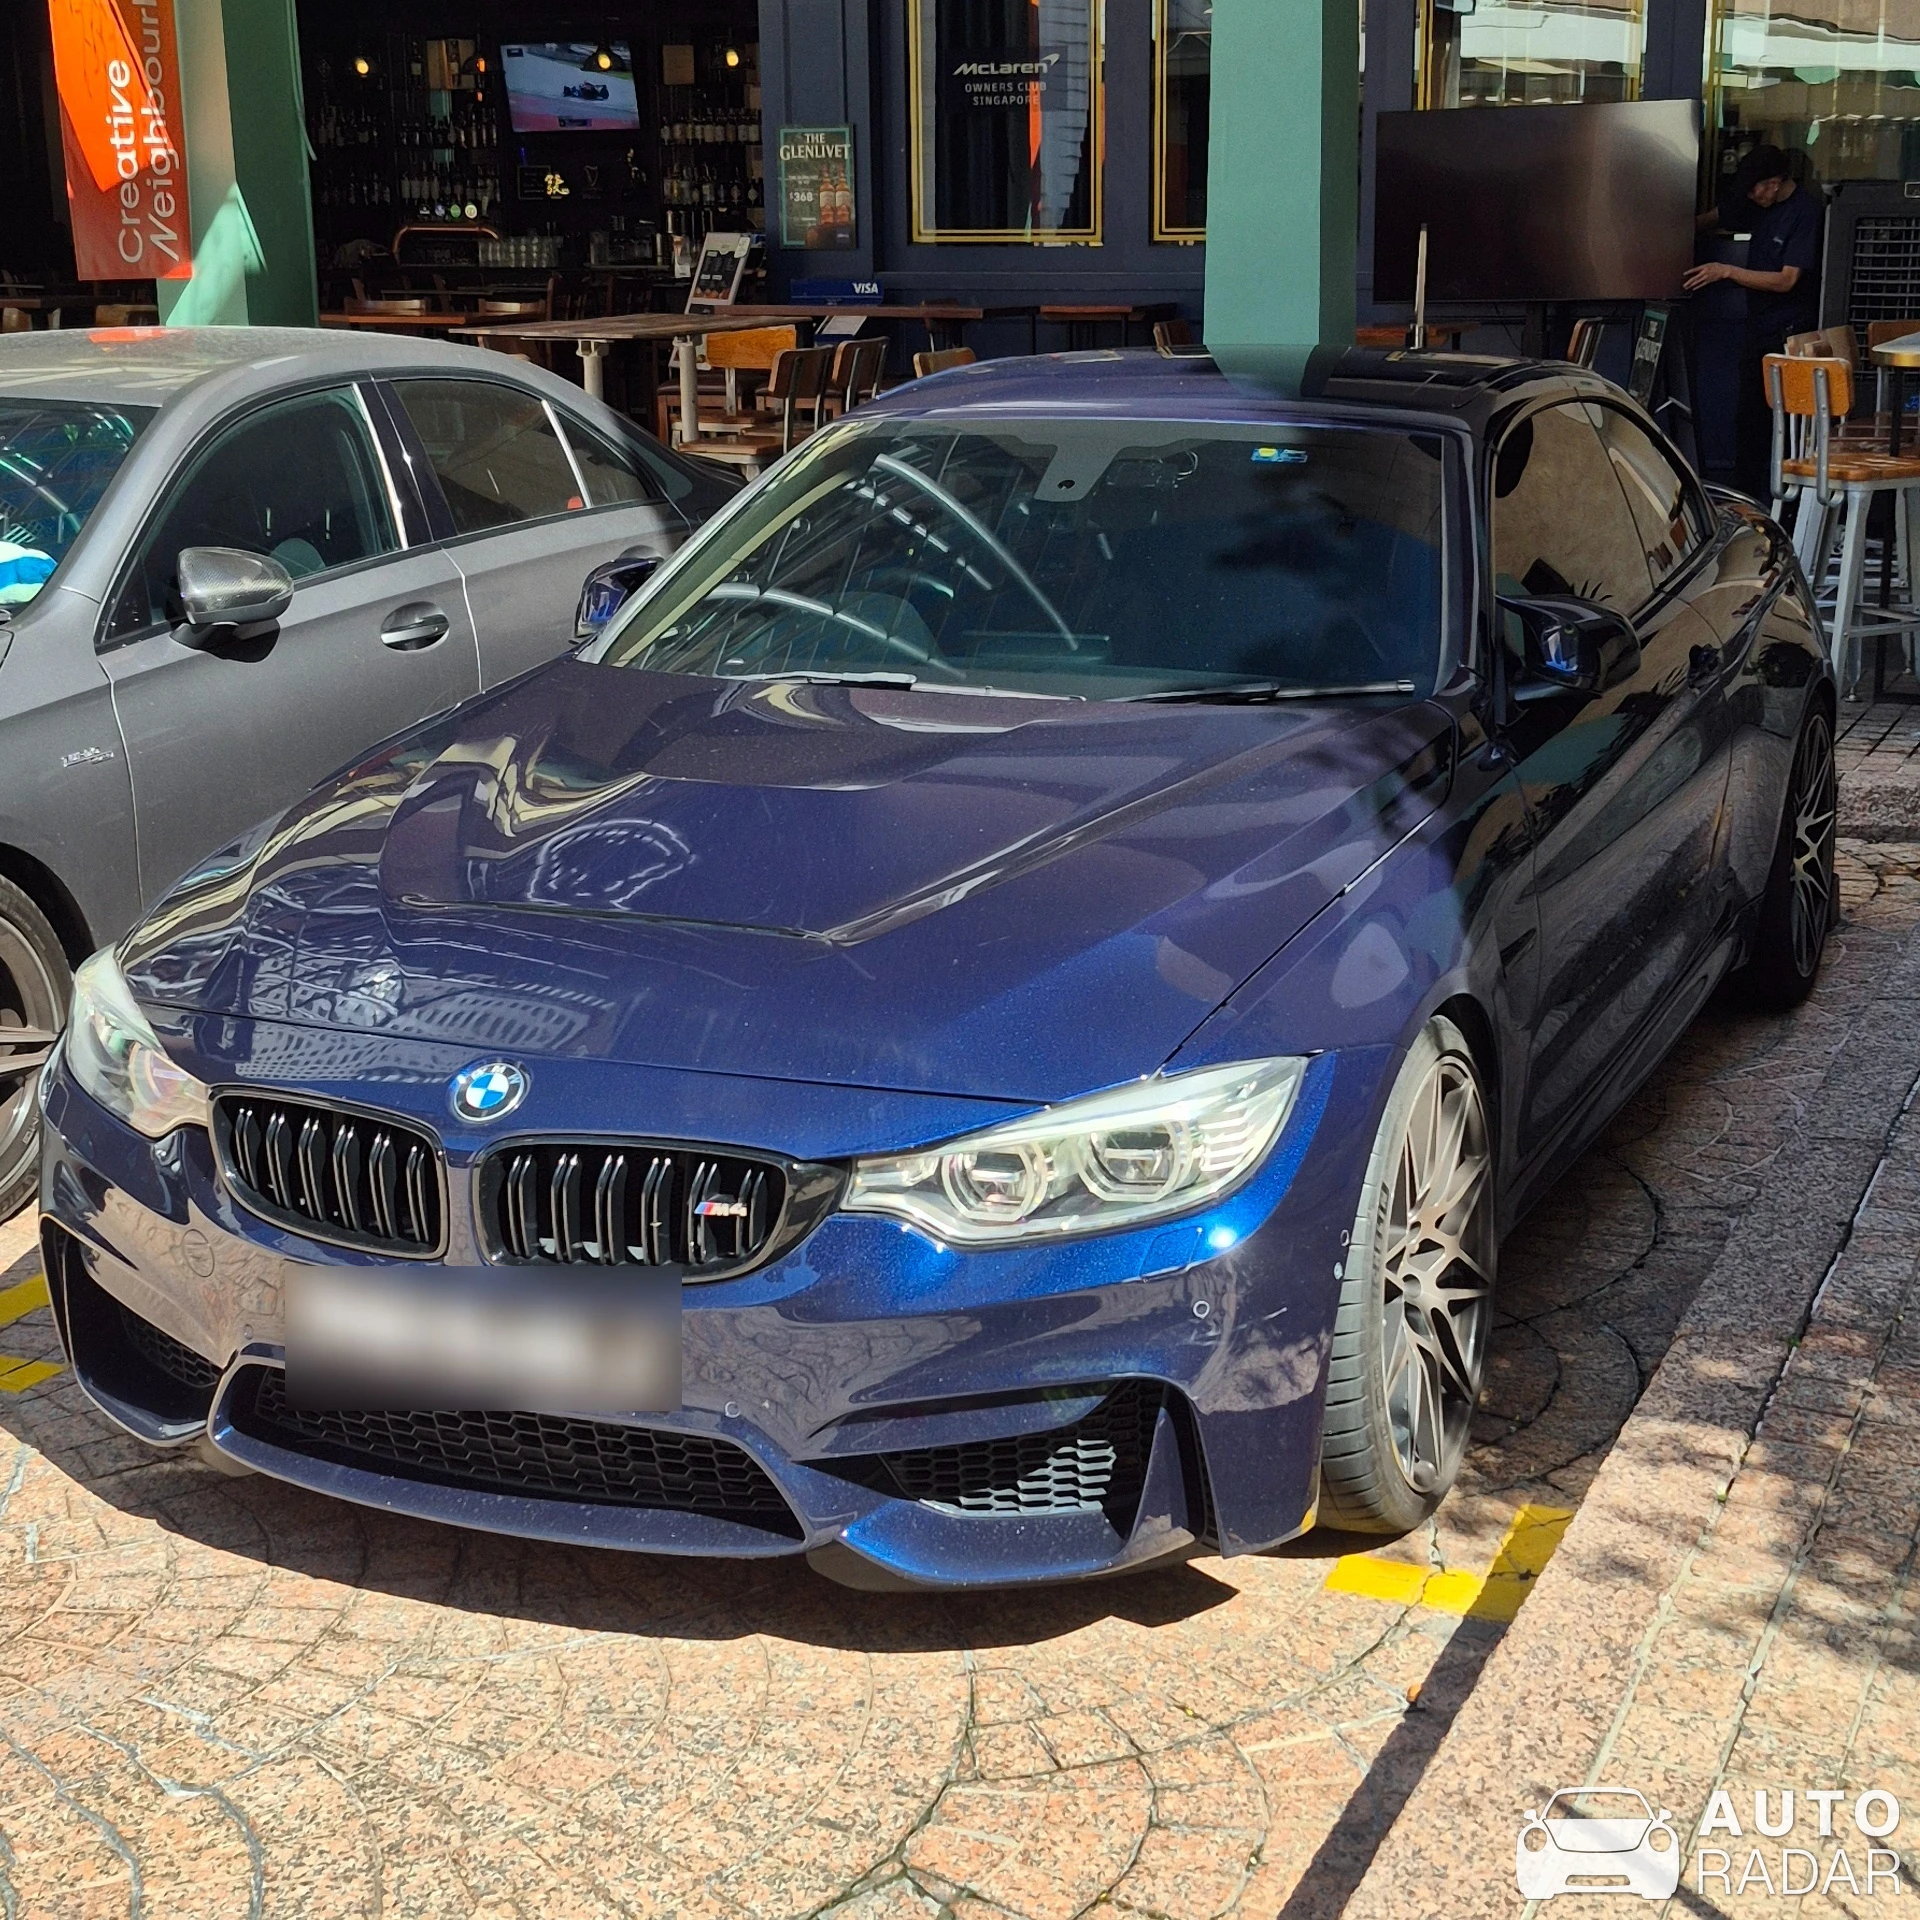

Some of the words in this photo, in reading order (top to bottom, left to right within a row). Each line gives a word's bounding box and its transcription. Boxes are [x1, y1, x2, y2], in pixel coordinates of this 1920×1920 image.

[952, 62, 1048, 76] McLaren
[964, 82, 1013, 93] OWNERS
[1017, 81, 1047, 92] CLUB
[972, 95, 1040, 106] SINGAPORE
[131, 0, 180, 262] Neighbour
[804, 133, 826, 144] THE
[780, 144, 851, 161] GLENLIVET
[105, 59, 144, 264] Creative
[789, 191, 814, 202] $368
[852, 282, 879, 294] VISA
[470, 1065, 521, 1085] BMW
[711, 1202, 747, 1217] M4
